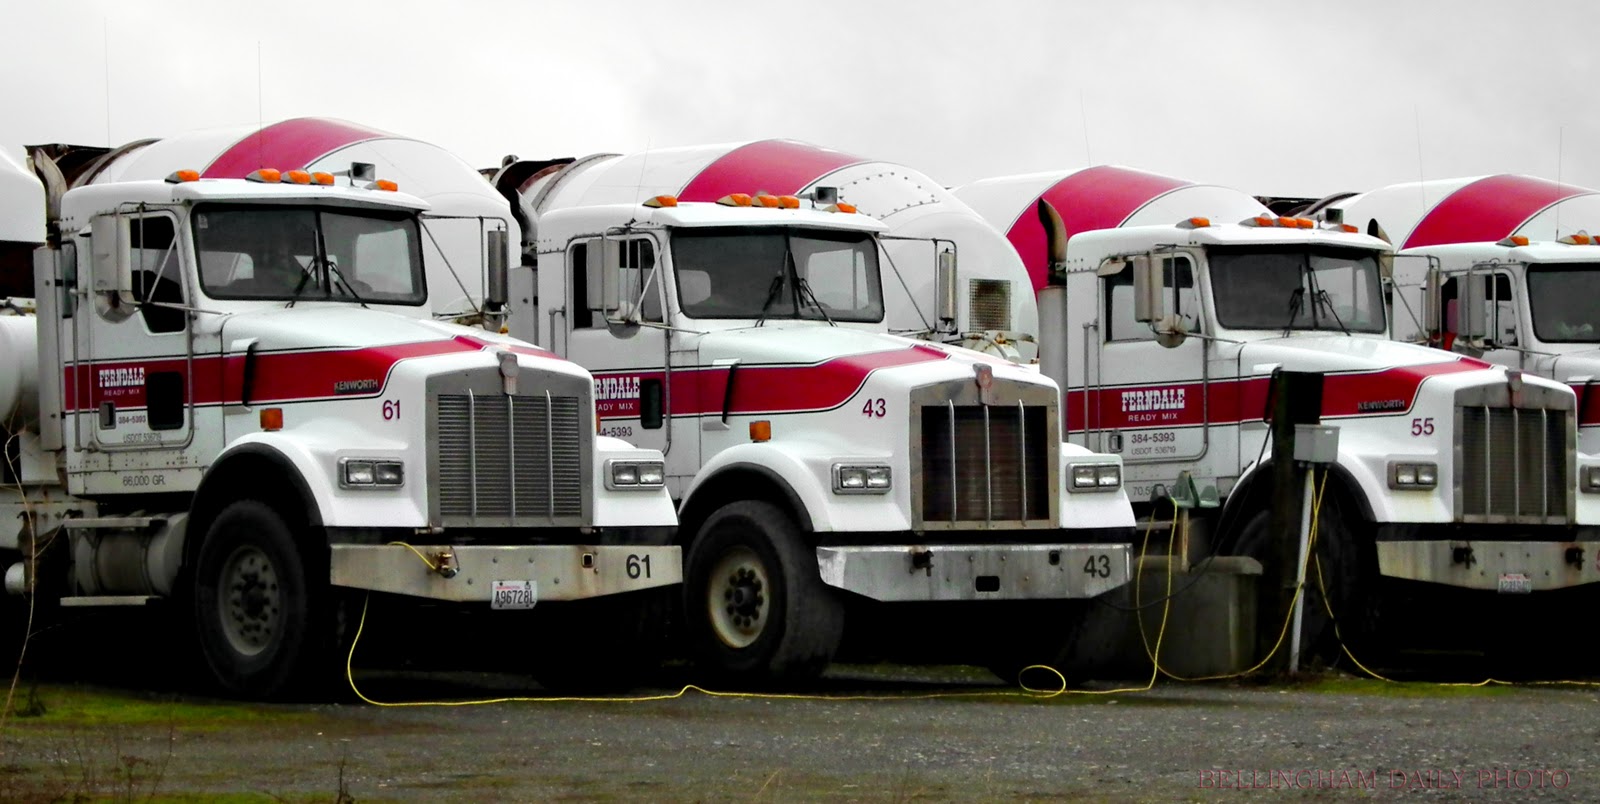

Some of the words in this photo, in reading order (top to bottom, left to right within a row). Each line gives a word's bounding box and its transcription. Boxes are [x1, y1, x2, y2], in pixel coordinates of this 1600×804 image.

[99, 367, 145, 388] FERNDALE
[334, 379, 379, 391] KENWORTH
[594, 377, 640, 399] RNDALE
[597, 403, 614, 411] ADY
[618, 402, 634, 410] MIX
[1121, 388, 1185, 412] FERNDALE
[1357, 400, 1405, 410] KENWORTH
[382, 399, 401, 420] 61
[862, 398, 887, 418] 43
[601, 426, 633, 437] 4-5393
[1411, 418, 1435, 436] 55
[1131, 432, 1175, 444] 384-5393
[1131, 447, 1152, 455] USDOT
[123, 475, 149, 487] 66,000
[1133, 486, 1156, 497] 70,5
[626, 554, 651, 579] 61
[1083, 555, 1111, 577] 43
[495, 590, 535, 604] A96728L
